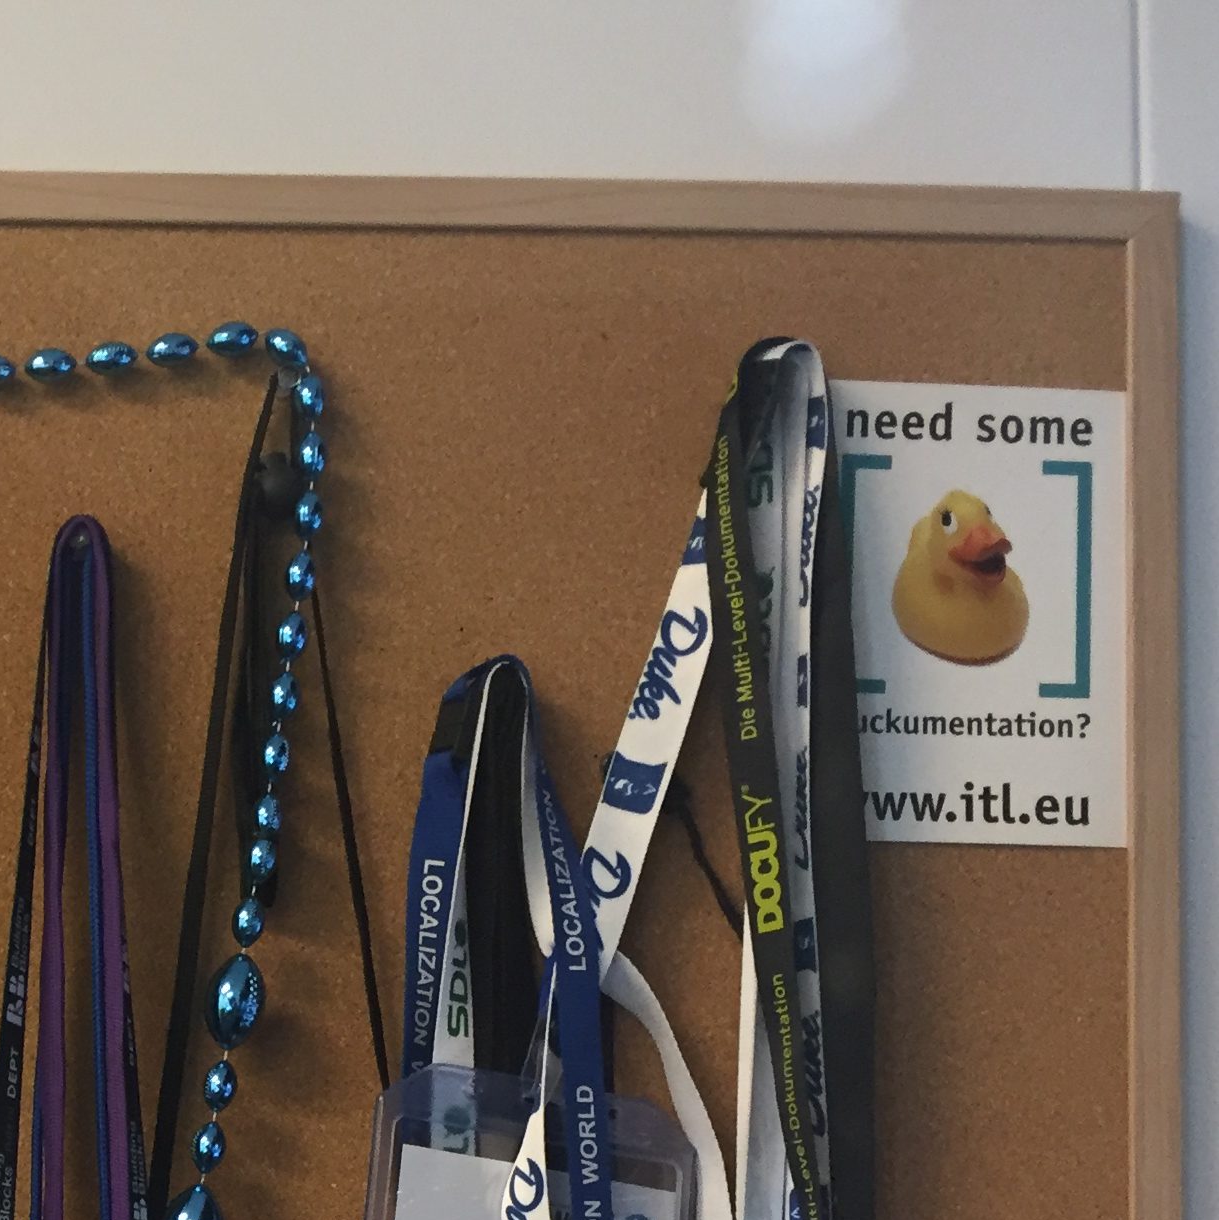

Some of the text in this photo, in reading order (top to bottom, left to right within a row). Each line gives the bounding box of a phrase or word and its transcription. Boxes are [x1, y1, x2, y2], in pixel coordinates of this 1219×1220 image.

[845, 402, 1093, 447] need some
[741, 708, 756, 741] Die
[857, 708, 1091, 738] uckumentation?
[540, 791, 588, 972] LOCALIZATION
[413, 858, 445, 1047] LOCALIZATION
[8, 1047, 19, 1099] DEPT
[576, 1085, 600, 1185] WORLD
